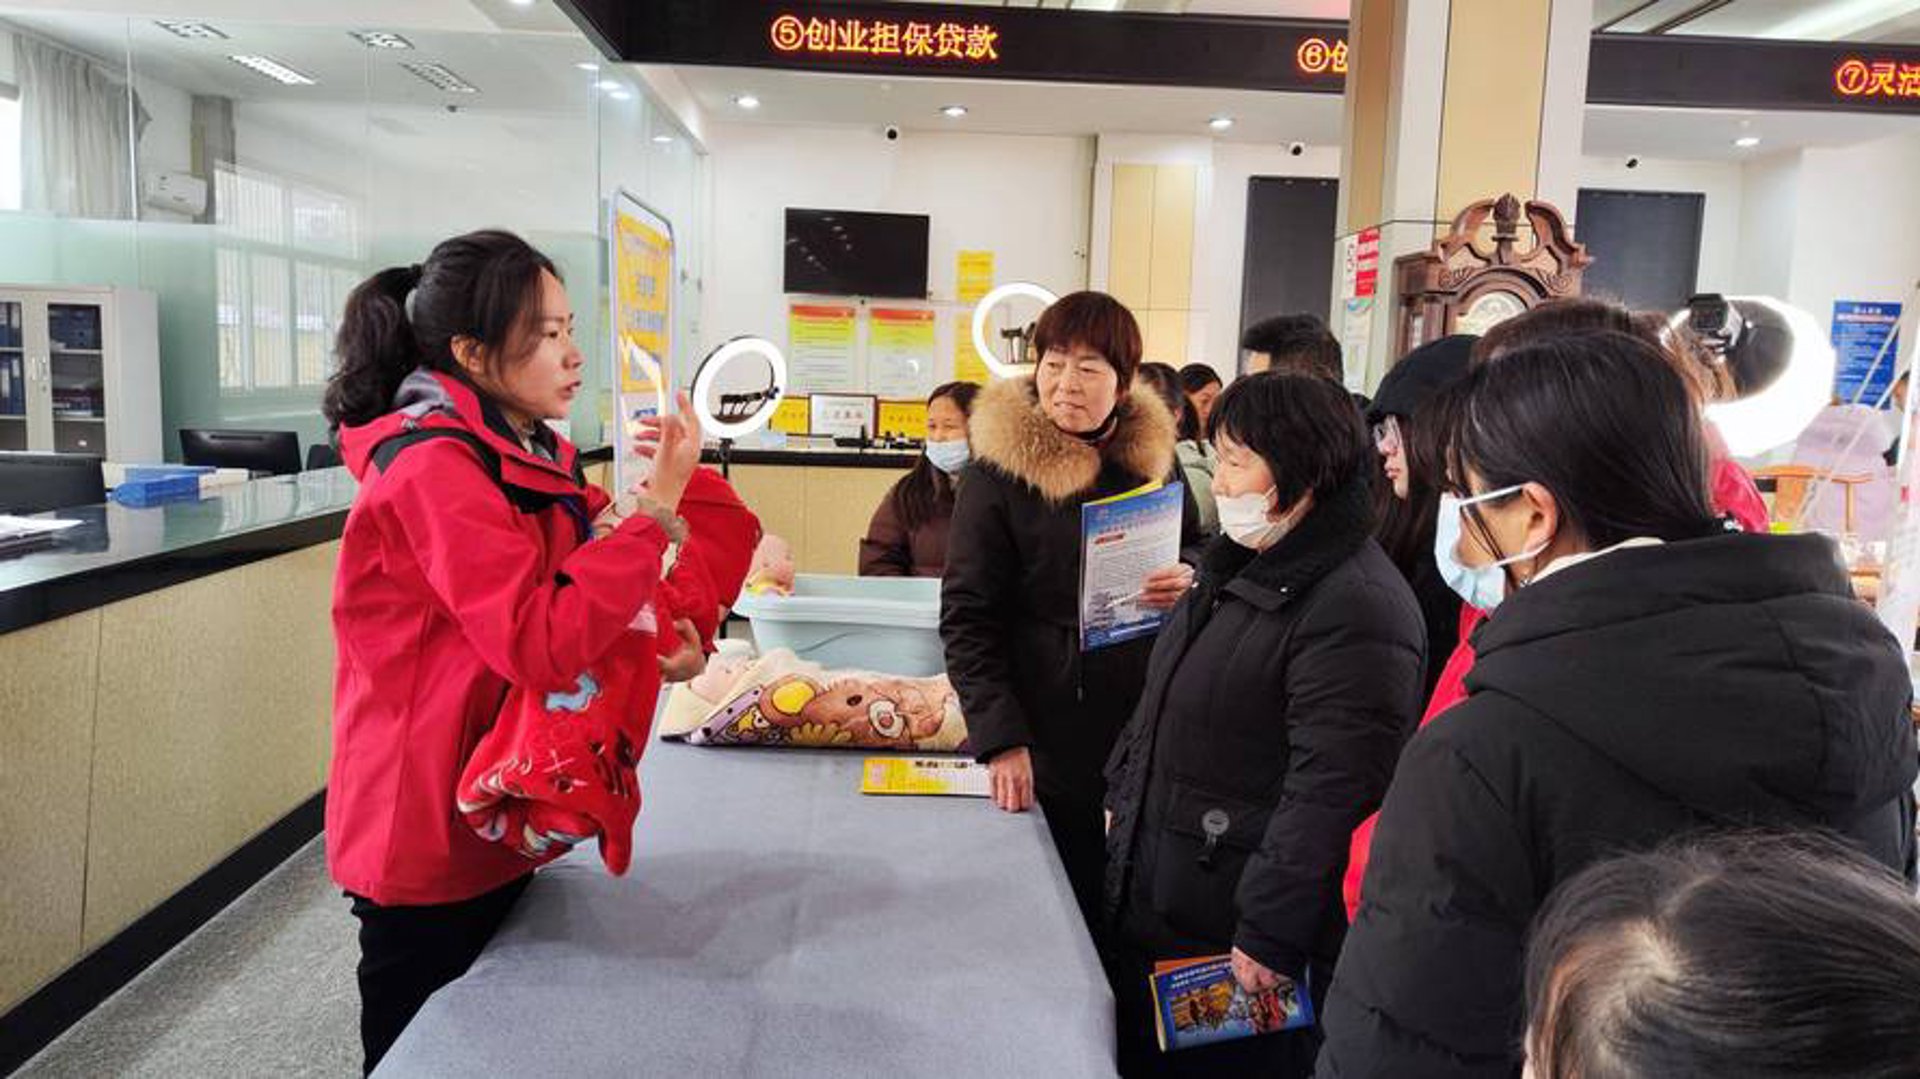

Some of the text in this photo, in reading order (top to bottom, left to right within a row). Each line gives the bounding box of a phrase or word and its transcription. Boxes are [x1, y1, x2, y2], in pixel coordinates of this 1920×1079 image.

[771, 14, 998, 59] ⑤创业担保贷款
[1836, 60, 1920, 96] ⑦灵活
